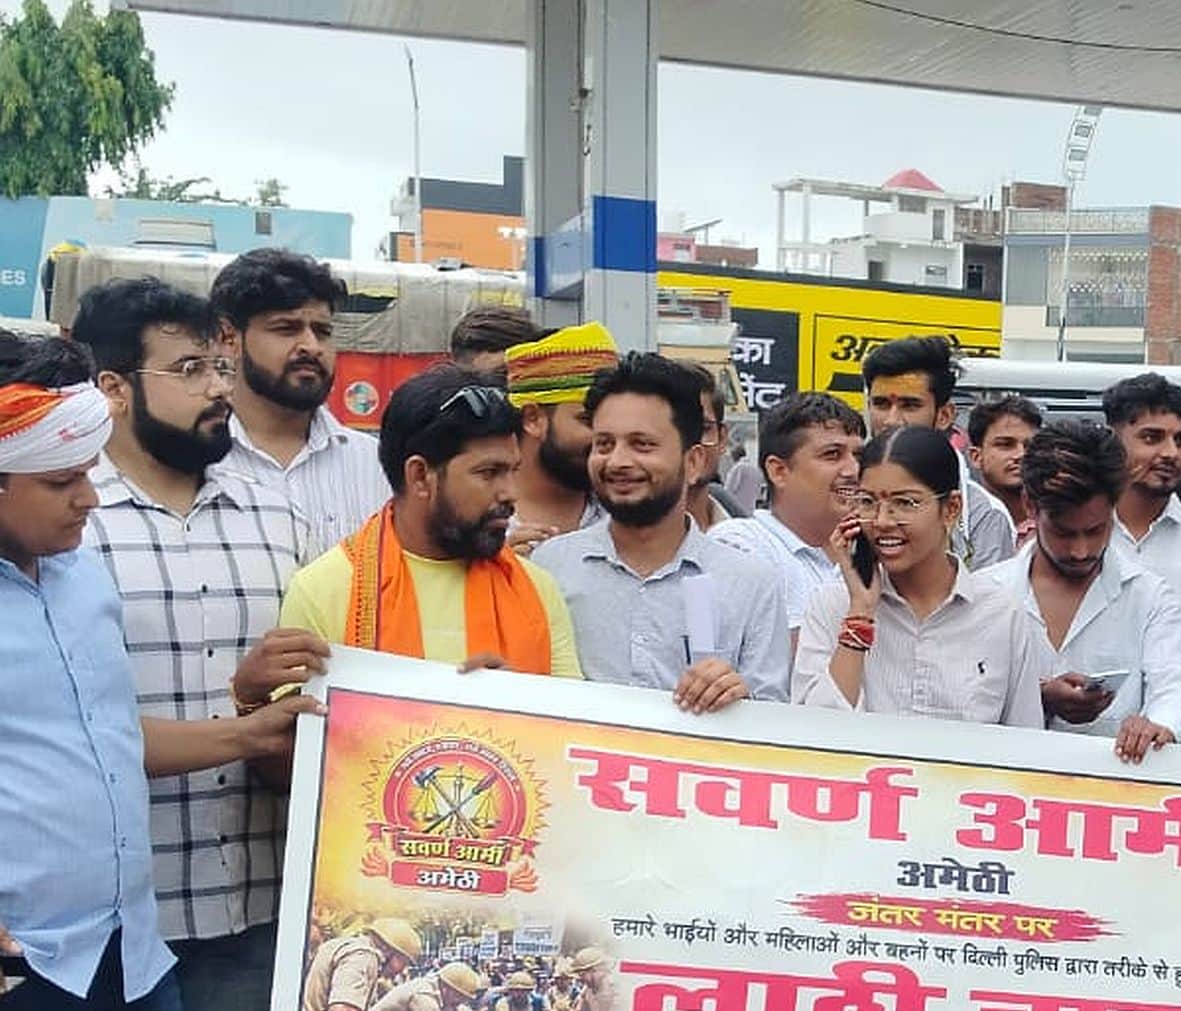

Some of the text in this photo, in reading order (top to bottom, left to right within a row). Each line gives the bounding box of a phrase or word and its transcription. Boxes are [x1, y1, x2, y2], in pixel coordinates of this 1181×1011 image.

[569, 748, 918, 841] सवर्ण
[417, 867, 480, 889] अमेठी
[897, 857, 1015, 895] अमेठी
[847, 896, 1059, 939] जंतर मंतर पर
[611, 914, 656, 938] हमारे
[663, 919, 717, 946] भाईयों
[724, 923, 759, 947] और
[765, 927, 840, 953] महिलाओं
[846, 933, 881, 957] और
[885, 938, 929, 963] बहनों
[933, 946, 957, 965] पर
[963, 943, 1008, 968] दिल्ली
[1013, 948, 1059, 976] पुलिस
[1064, 956, 1100, 976] द्वारा
[1103, 956, 1150, 979] तरीके
[1152, 961, 1169, 980] से
